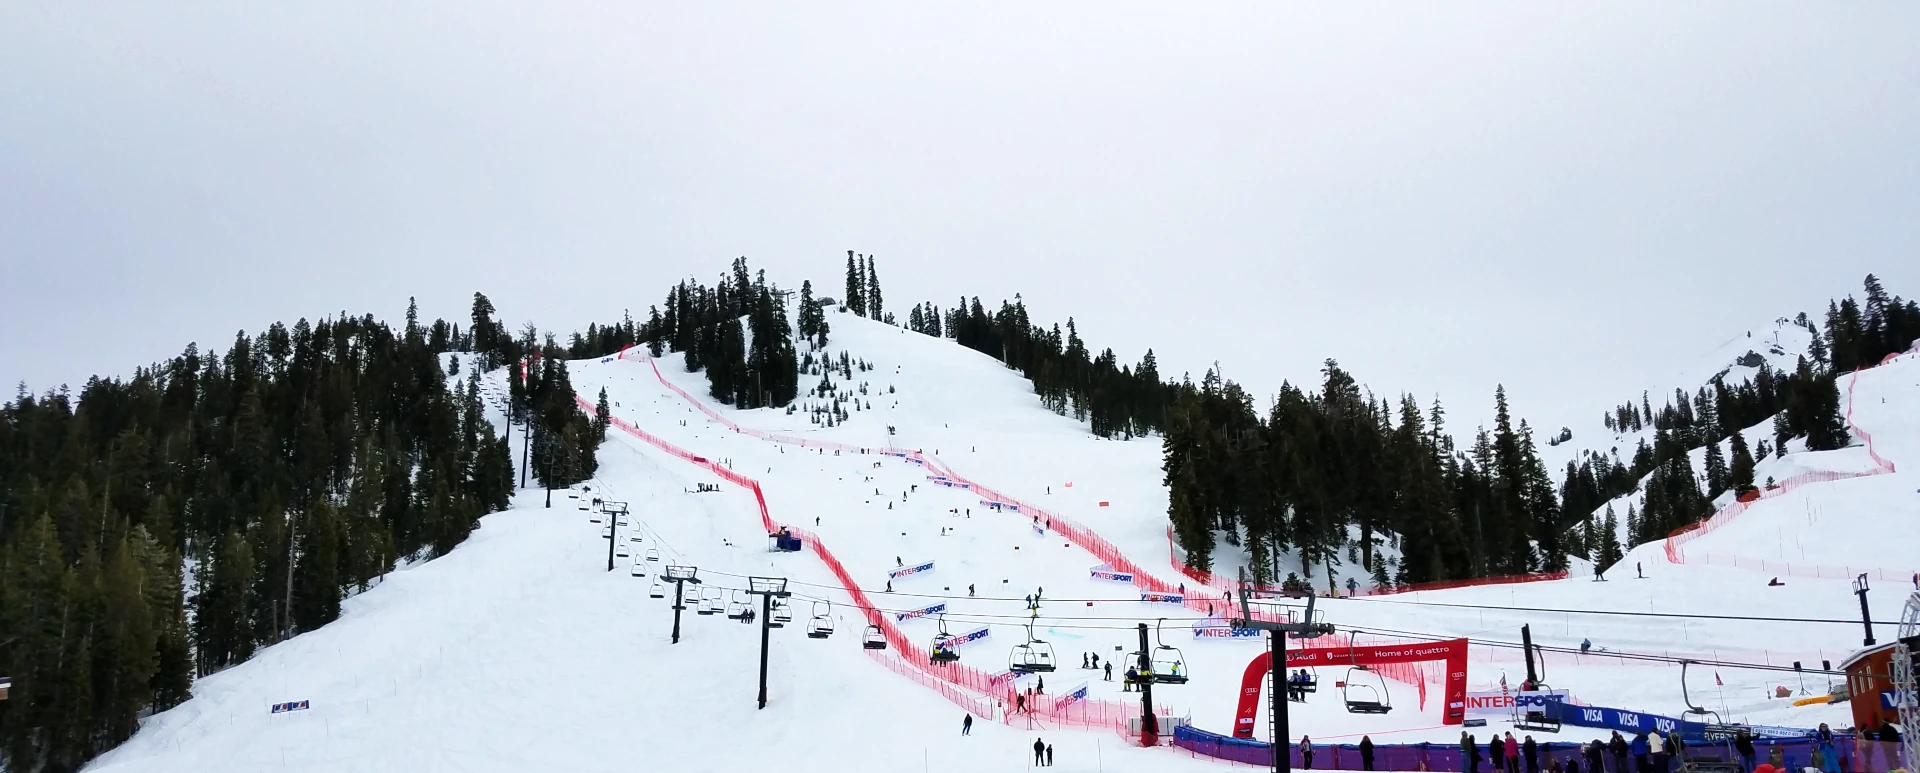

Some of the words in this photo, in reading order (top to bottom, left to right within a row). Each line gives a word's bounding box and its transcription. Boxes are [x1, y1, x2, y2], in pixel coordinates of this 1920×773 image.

[897, 562, 934, 578] INTERSPORT
[1095, 571, 1133, 583] INTERSPORT
[1146, 593, 1183, 604] INTERSPORT
[904, 604, 946, 620] INTERSPORT
[944, 629, 989, 648] INTERSPORT
[1203, 629, 1260, 638] INTERSPORT
[1415, 646, 1450, 657] quattro
[1582, 708, 1603, 723] VISA
[1616, 711, 1640, 728] VISA
[1654, 717, 1676, 733] VISA
